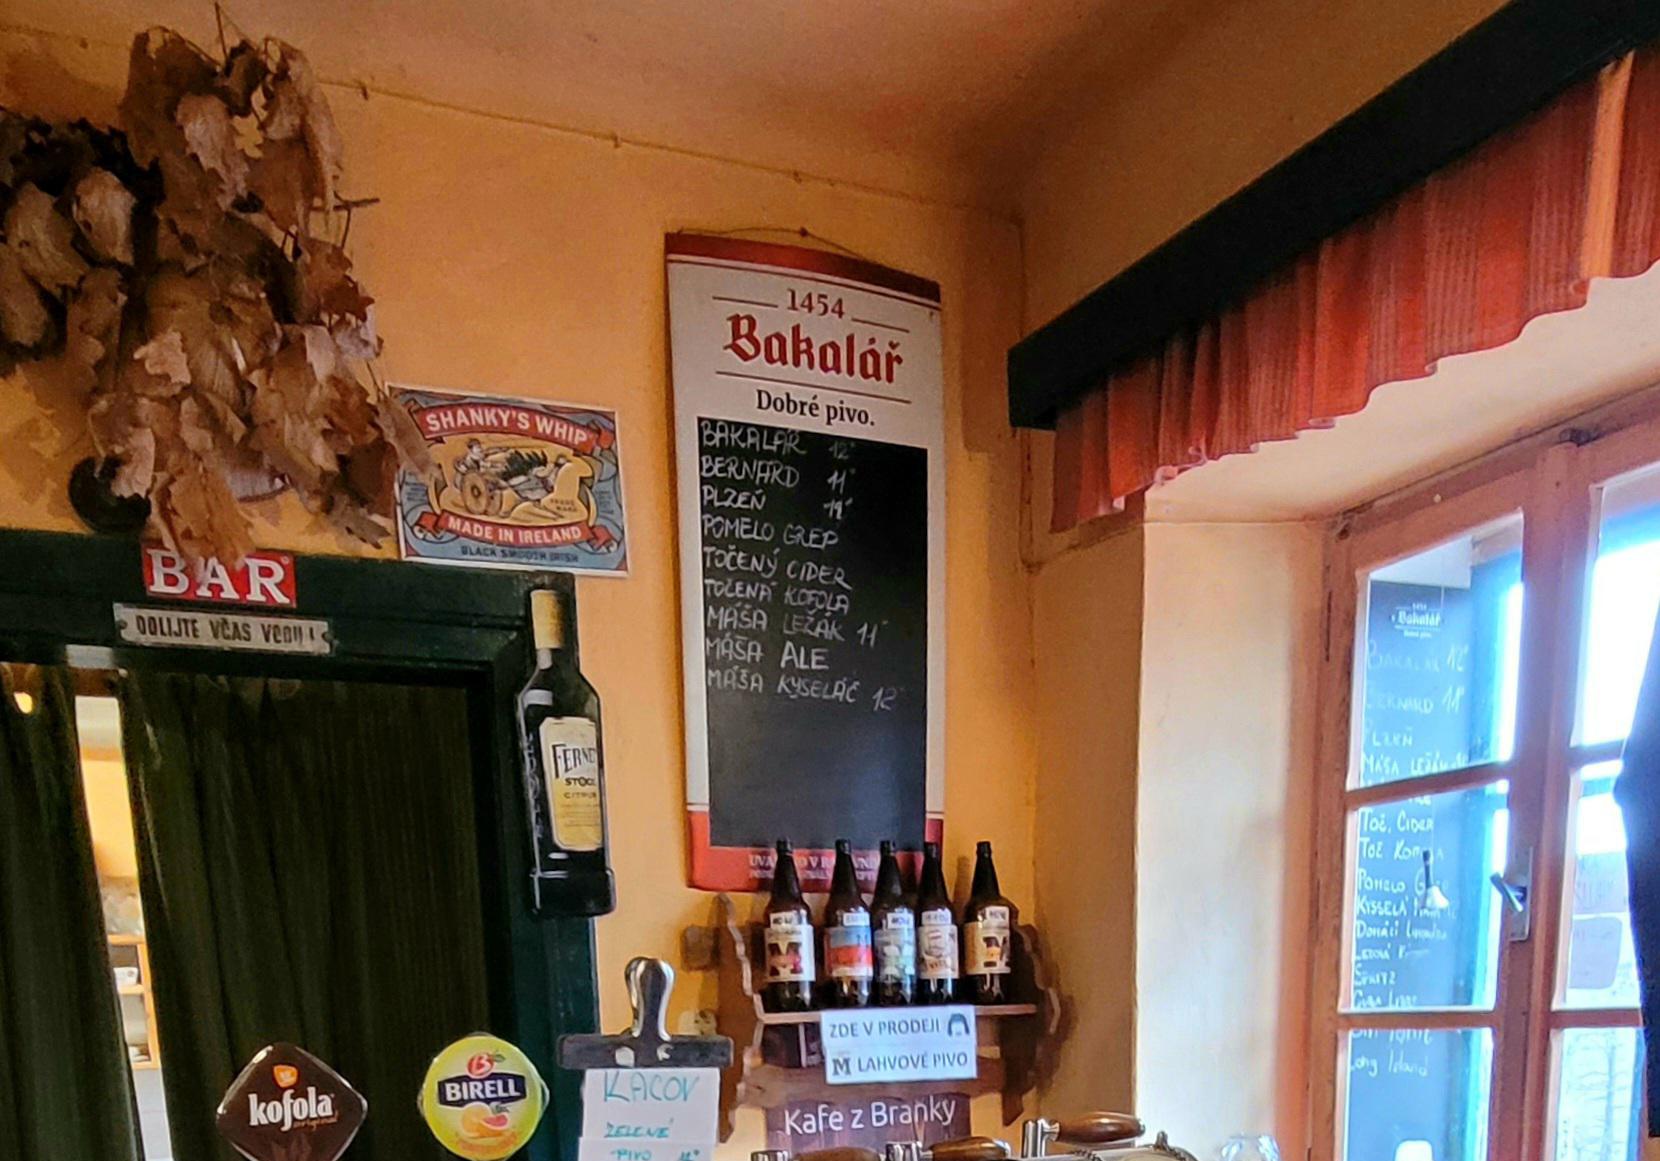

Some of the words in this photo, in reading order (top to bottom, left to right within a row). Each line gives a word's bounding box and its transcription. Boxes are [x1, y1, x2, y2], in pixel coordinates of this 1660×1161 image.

[787, 288, 845, 319] 1454
[723, 313, 903, 384] Bakalář
[756, 389, 820, 418] Dobré
[825, 402, 875, 426] pivo.
[425, 407, 530, 433] SHANKY'S
[534, 414, 588, 445] WHIP
[701, 455, 799, 488] BERNARD
[448, 516, 493, 540] MADE
[498, 528, 514, 543] IN
[518, 525, 582, 543] IRELAND
[702, 513, 775, 542] POMELO
[783, 524, 839, 550] GREP
[146, 549, 291, 604] BAR
[704, 545, 780, 579] TOČENÝ
[787, 560, 853, 591] CIDER
[210, 617, 252, 642] VČAS
[707, 602, 768, 631] MÁŠA
[705, 633, 764, 663] MÁŠA
[780, 640, 829, 671] ALE
[707, 665, 764, 692] MÁŠA
[829, 1023, 859, 1038] ZDE
[863, 1022, 874, 1036] V
[878, 1018, 940, 1035] PRODEJI
[858, 1052, 929, 1073] LAHVOVÉ
[933, 1052, 968, 1068] PIVO
[444, 1078, 519, 1102] BIRELL
[248, 1086, 333, 1131] kofola
[785, 1104, 844, 1136] Kafe
[850, 1108, 864, 1129] z
[870, 1094, 956, 1127] Branky
